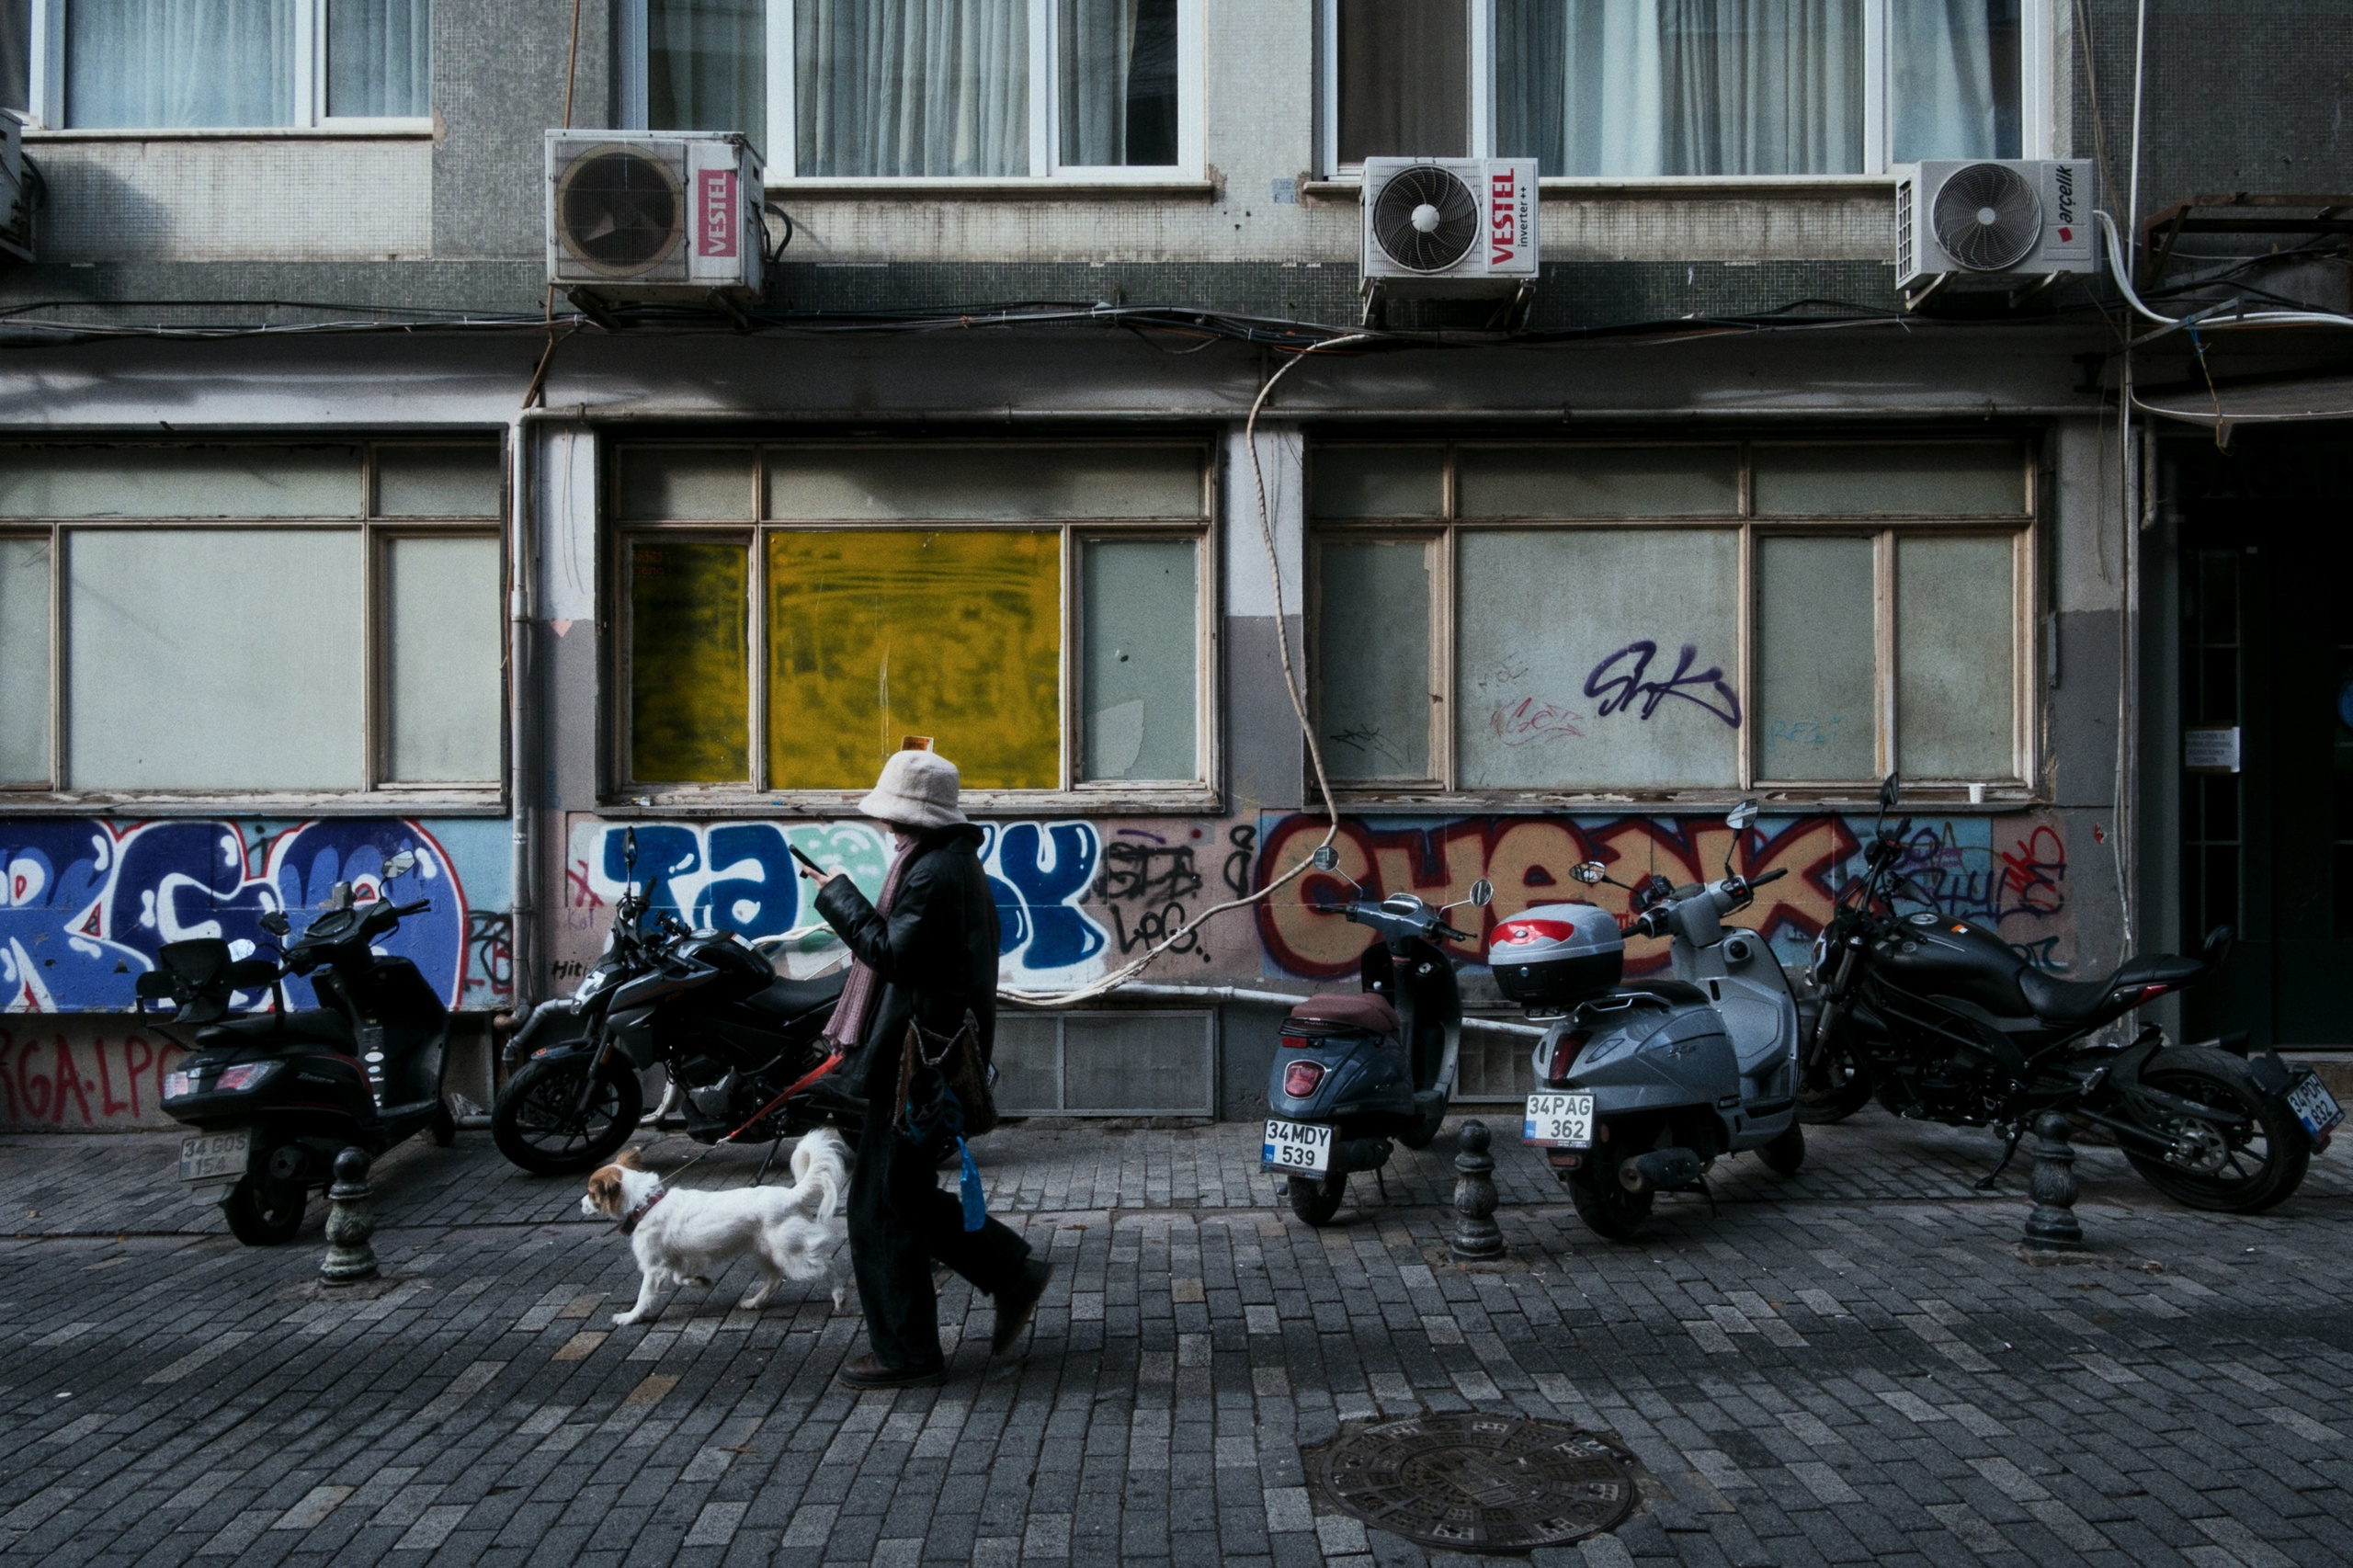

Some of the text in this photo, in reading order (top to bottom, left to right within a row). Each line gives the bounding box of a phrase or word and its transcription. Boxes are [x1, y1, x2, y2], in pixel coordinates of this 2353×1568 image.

[708, 172, 727, 255] VESTEL
[2055, 165, 2076, 224] arçelik
[1492, 167, 1515, 266] VESTEL
[1551, 1119, 1585, 1139] 362
[2311, 1099, 2334, 1126] 832
[1282, 1145, 1315, 1166] 539
